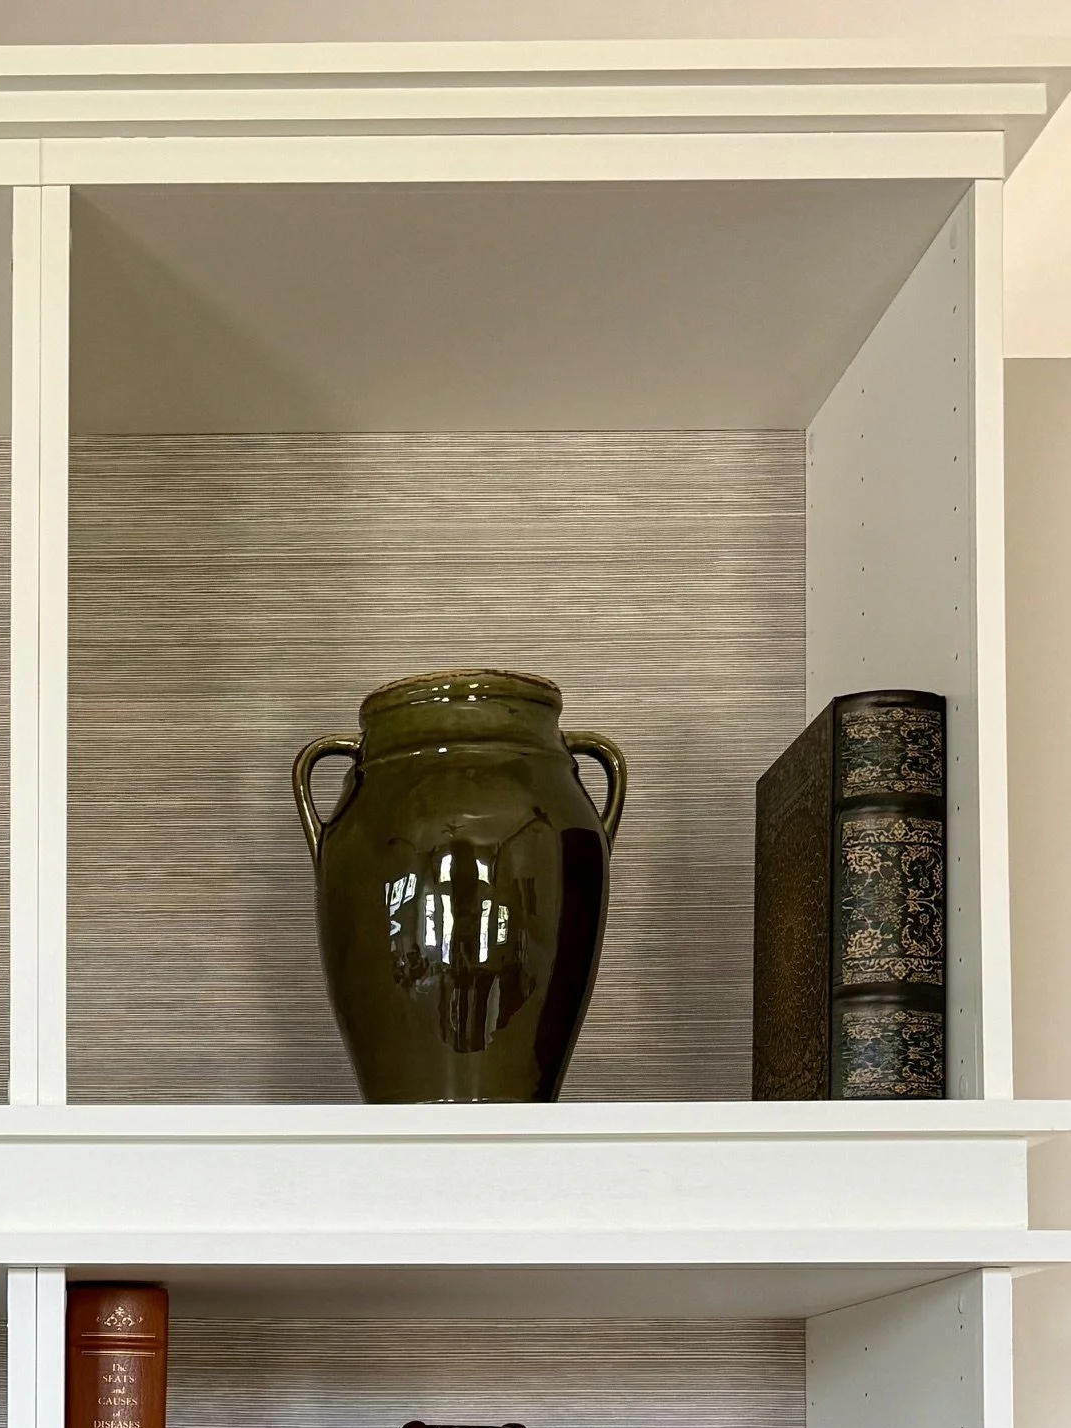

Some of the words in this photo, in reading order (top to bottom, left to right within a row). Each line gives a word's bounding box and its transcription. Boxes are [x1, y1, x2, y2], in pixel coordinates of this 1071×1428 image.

[102, 1374, 135, 1383] SEATS
[98, 1397, 138, 1406] CAUSES
[93, 1420, 141, 1428] DISEASES
